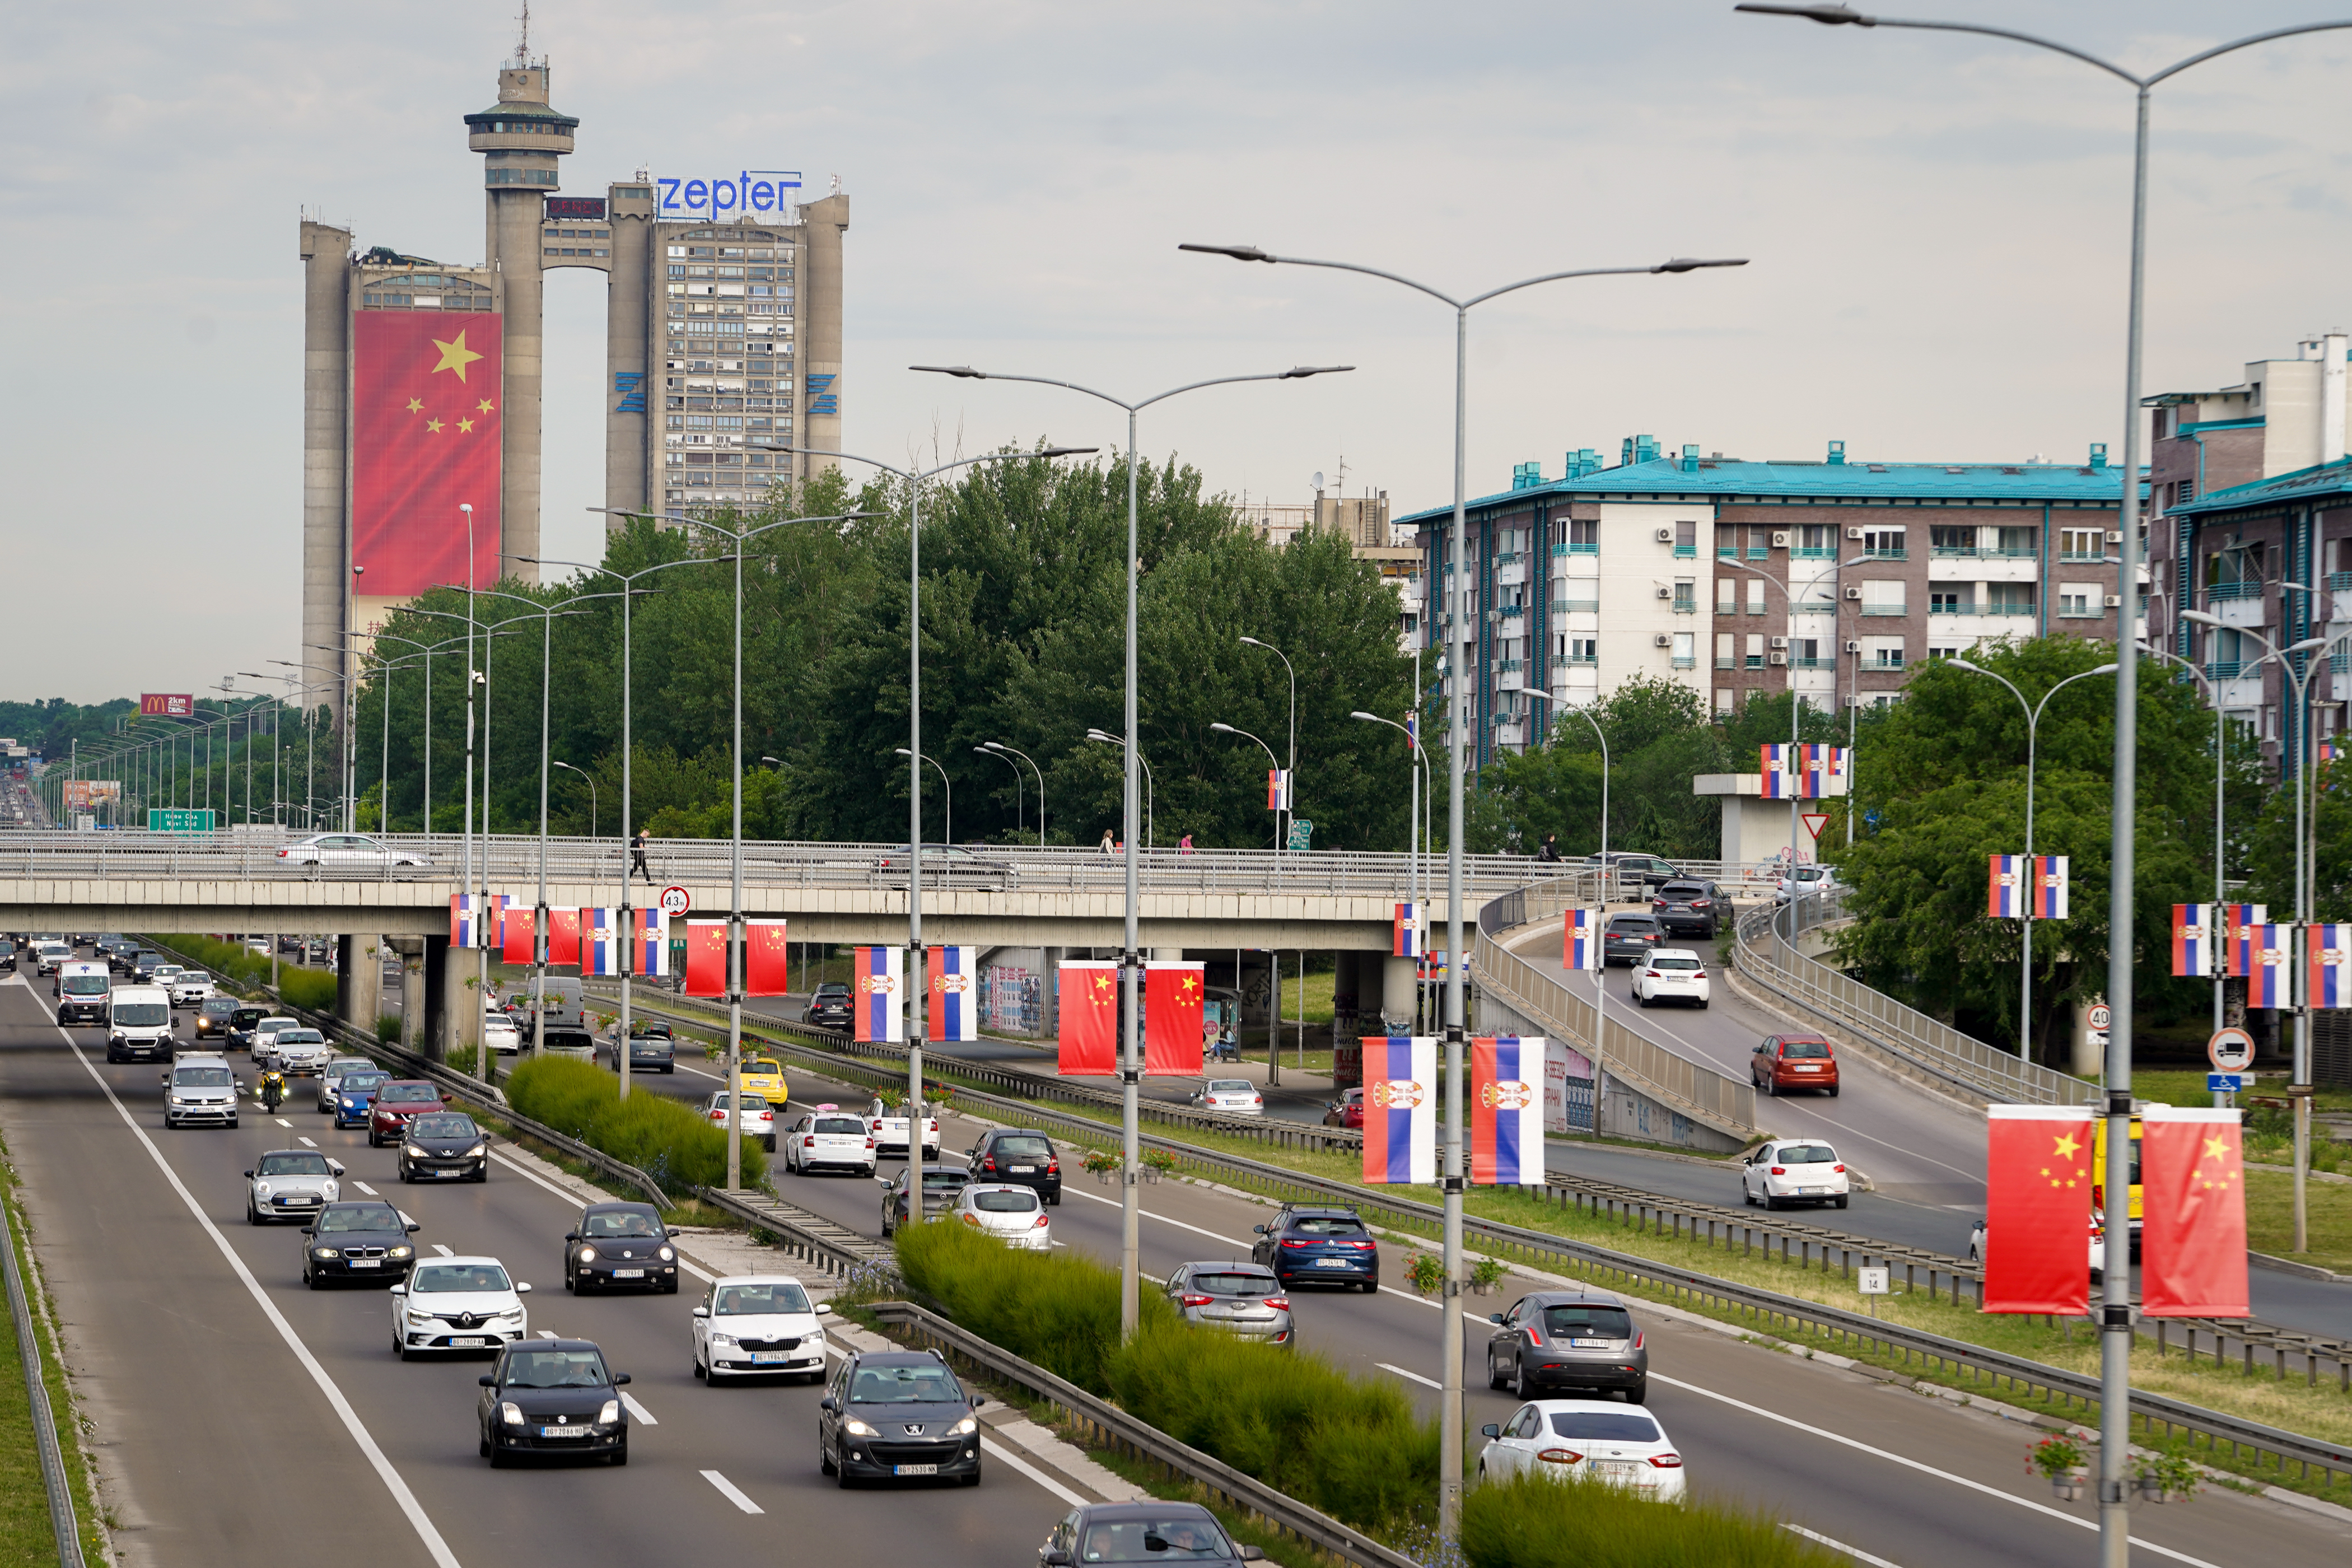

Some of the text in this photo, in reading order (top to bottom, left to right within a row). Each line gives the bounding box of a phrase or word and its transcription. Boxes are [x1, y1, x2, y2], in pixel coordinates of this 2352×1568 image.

[658, 171, 801, 220] zepter
[2093, 1011, 2109, 1024] 40
[1869, 1280, 1878, 1289] 14
